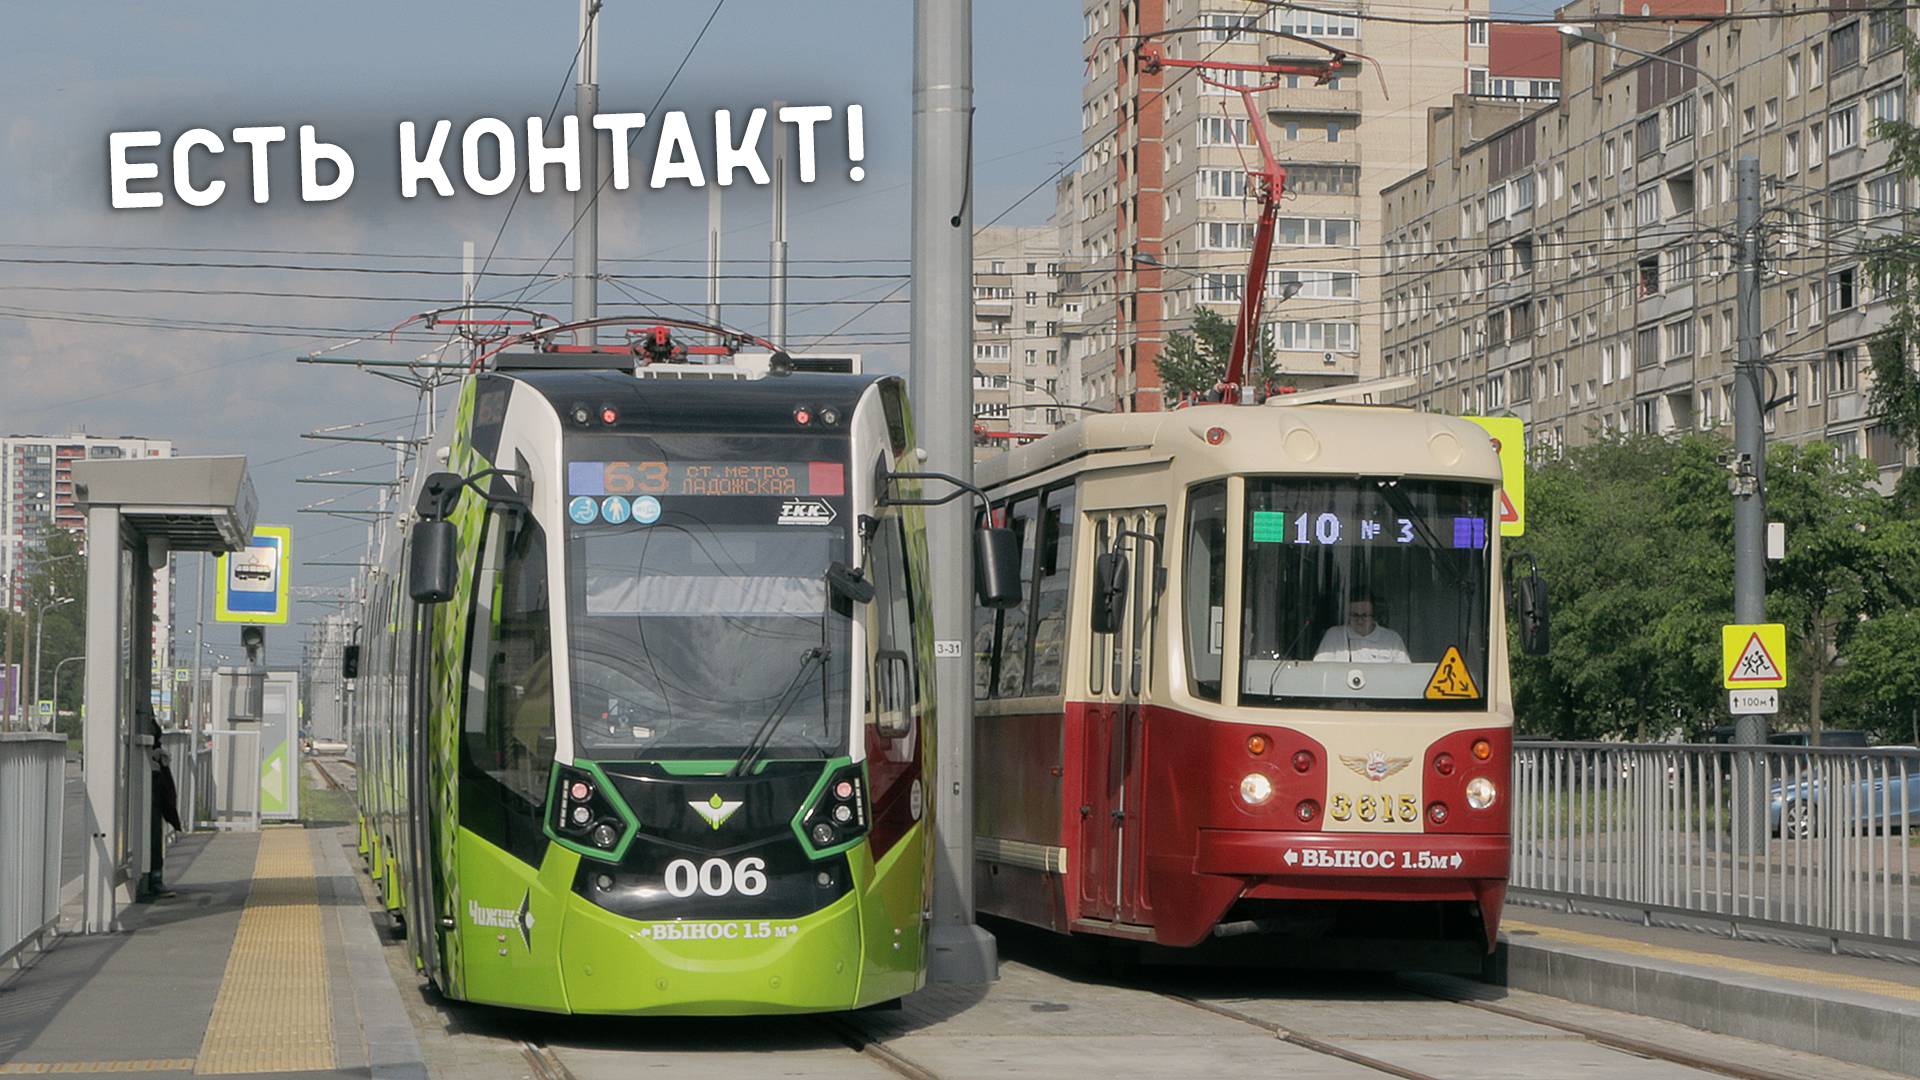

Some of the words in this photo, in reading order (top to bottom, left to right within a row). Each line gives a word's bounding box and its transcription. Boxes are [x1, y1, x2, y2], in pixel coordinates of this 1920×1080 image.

[604, 461, 669, 493] 63
[682, 478, 796, 496] ЛАДОЖСКАЯ
[1294, 512, 1340, 544] 10
[1397, 518, 1414, 543] 3
[936, 643, 960, 654] 3-31
[1742, 697, 1767, 706] 100м
[1330, 792, 1417, 823] 3615
[1301, 849, 1395, 869] ВЫНОС
[664, 857, 767, 898] 006
[652, 922, 738, 940] ВЫНОС
[743, 923, 771, 939] 1.5
